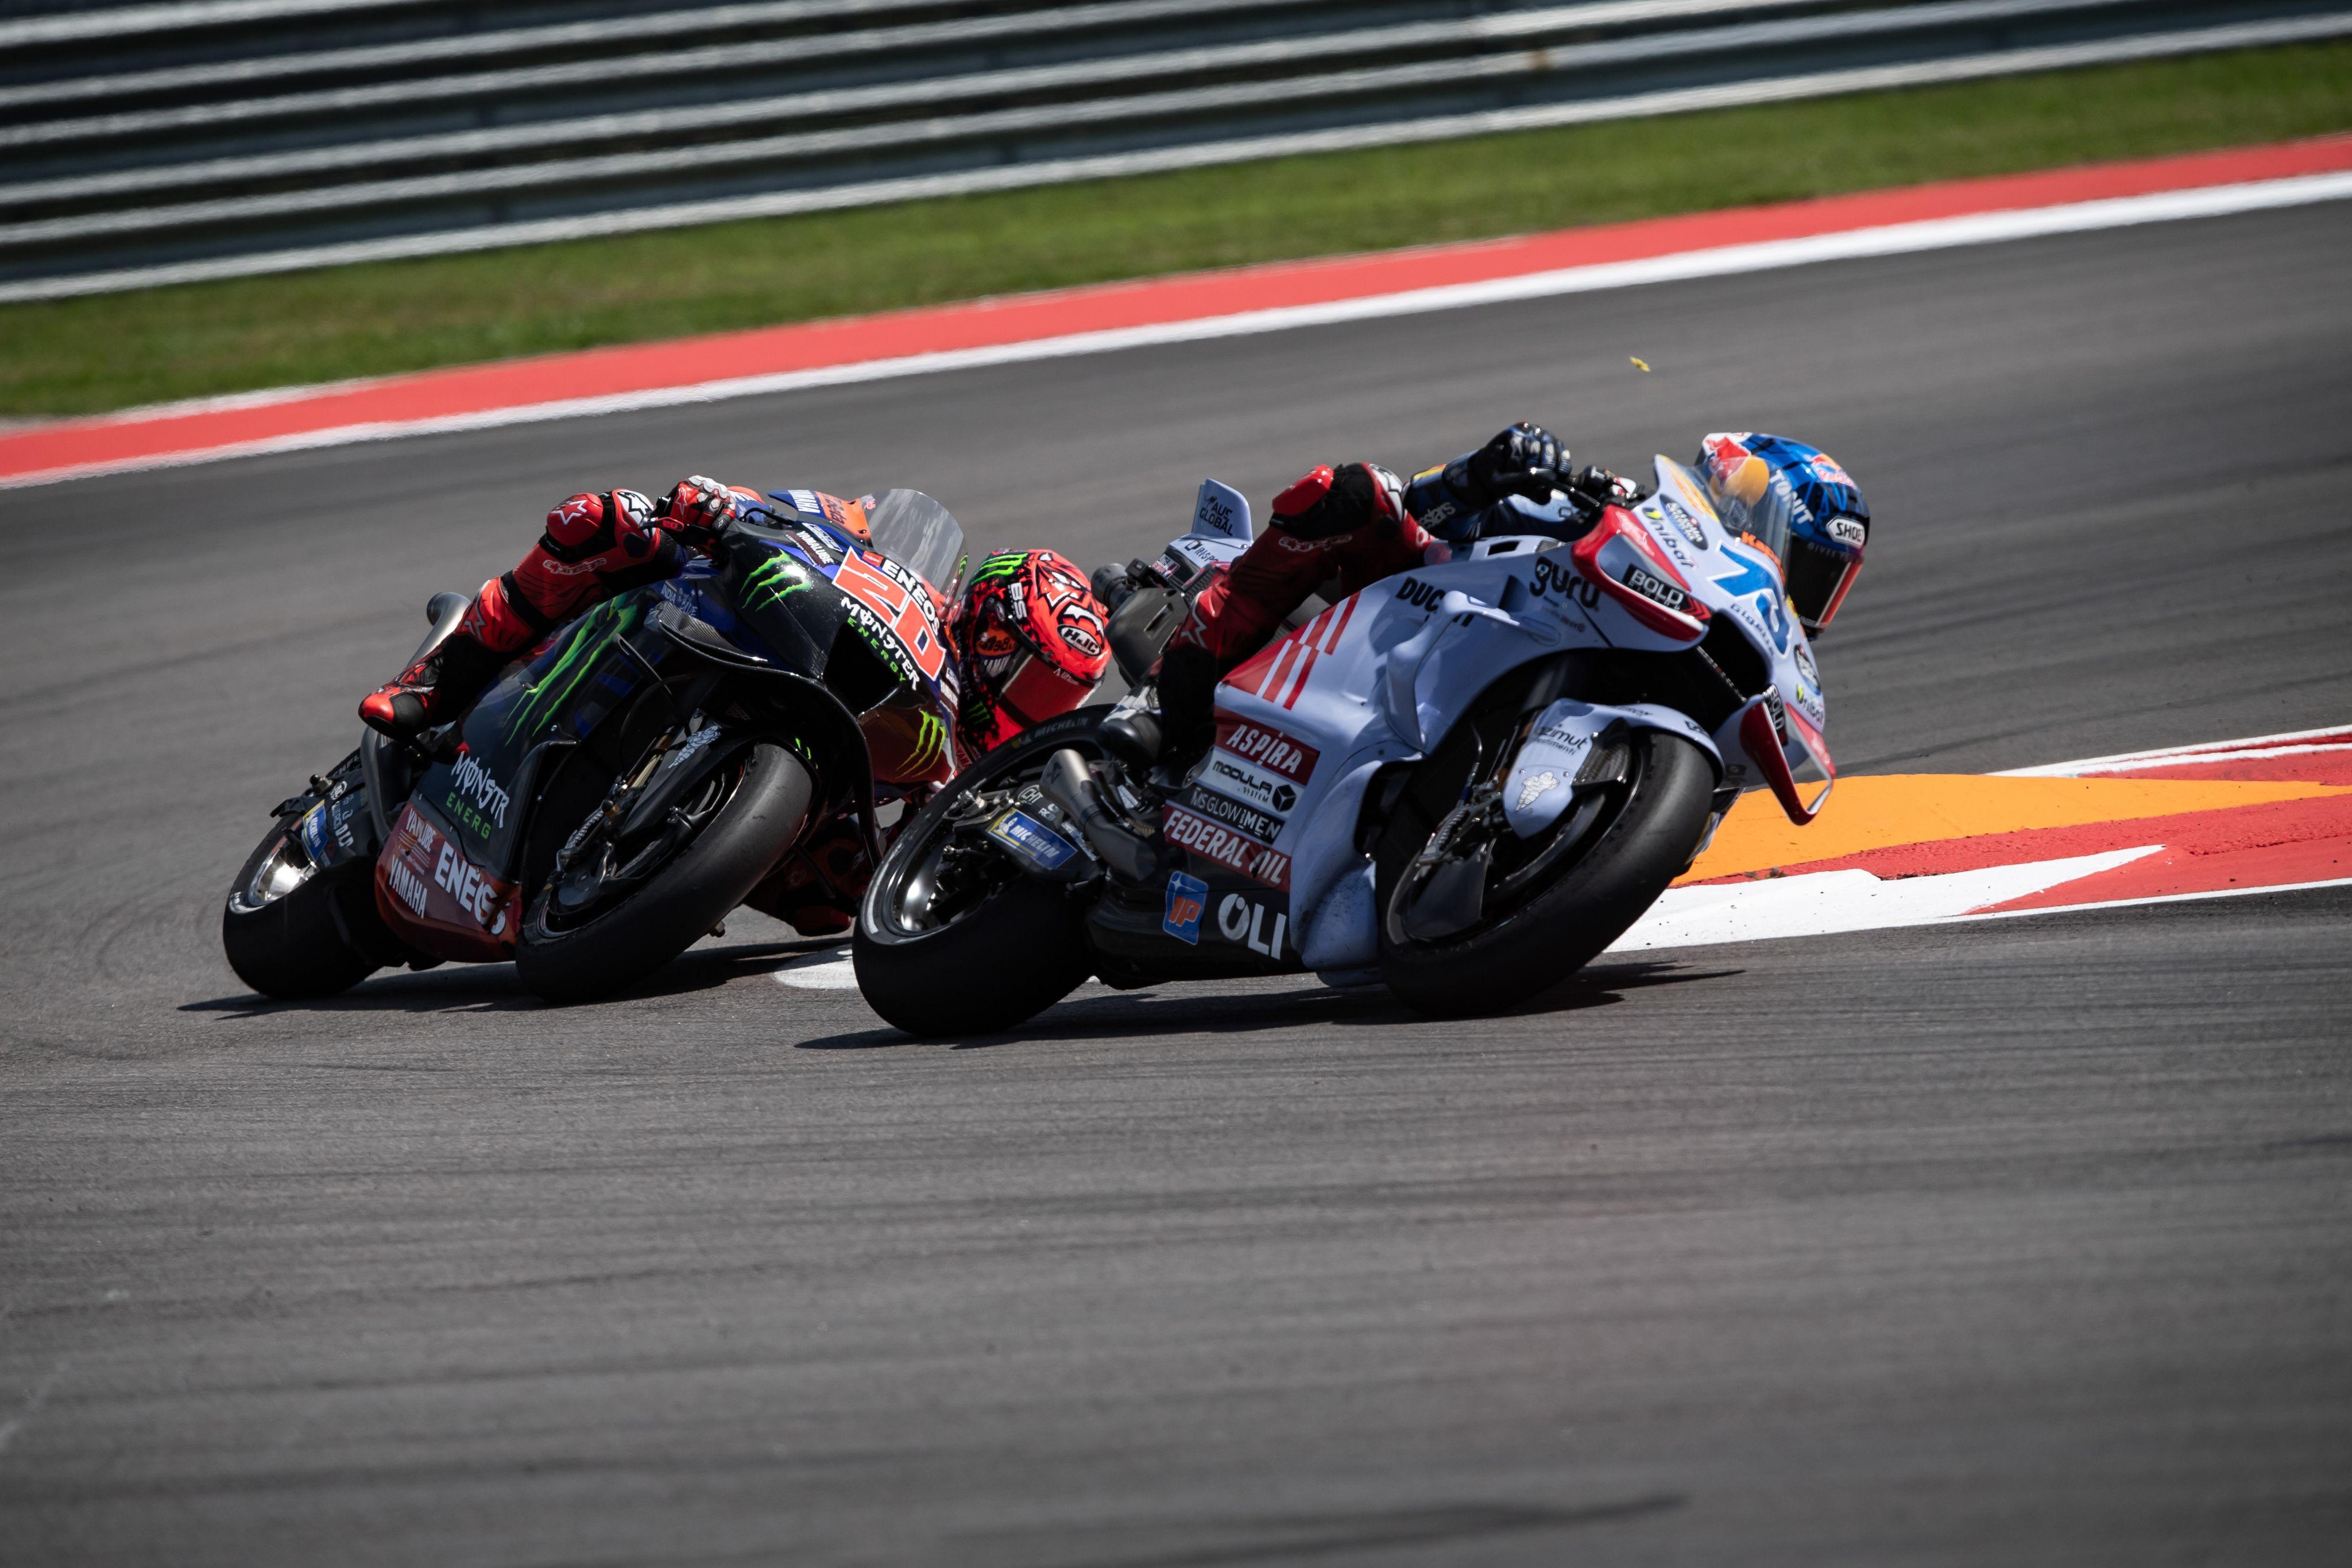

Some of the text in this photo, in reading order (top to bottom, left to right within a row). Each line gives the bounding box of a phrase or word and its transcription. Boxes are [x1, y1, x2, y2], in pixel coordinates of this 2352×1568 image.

[1200, 507, 1234, 536] GLOBAL
[796, 531, 834, 564] YAMALUBE
[661, 583, 676, 603] INDIA
[881, 559, 940, 636] ENEOS
[1529, 556, 1600, 608] guru
[1631, 568, 1683, 605] BOLD
[832, 546, 946, 682] 20
[841, 596, 920, 690] MONSTER
[848, 617, 906, 682] ENERGY
[1063, 629, 1098, 653] HJC
[1035, 718, 1088, 738] MICHELIN
[1226, 724, 1302, 774] ASPIRA
[451, 750, 510, 828] MONSTR
[1212, 760, 1272, 795] MODULA
[446, 792, 492, 839] ENERG
[1207, 796, 1243, 822] GLOW
[1245, 810, 1281, 839] MEN
[1009, 825, 1060, 858] MICHELIN
[1163, 810, 1287, 884] FEDERAL OIL
[389, 854, 427, 919] YAMAHA
[1168, 896, 1201, 927] IP
[1218, 893, 1287, 960] OLI
